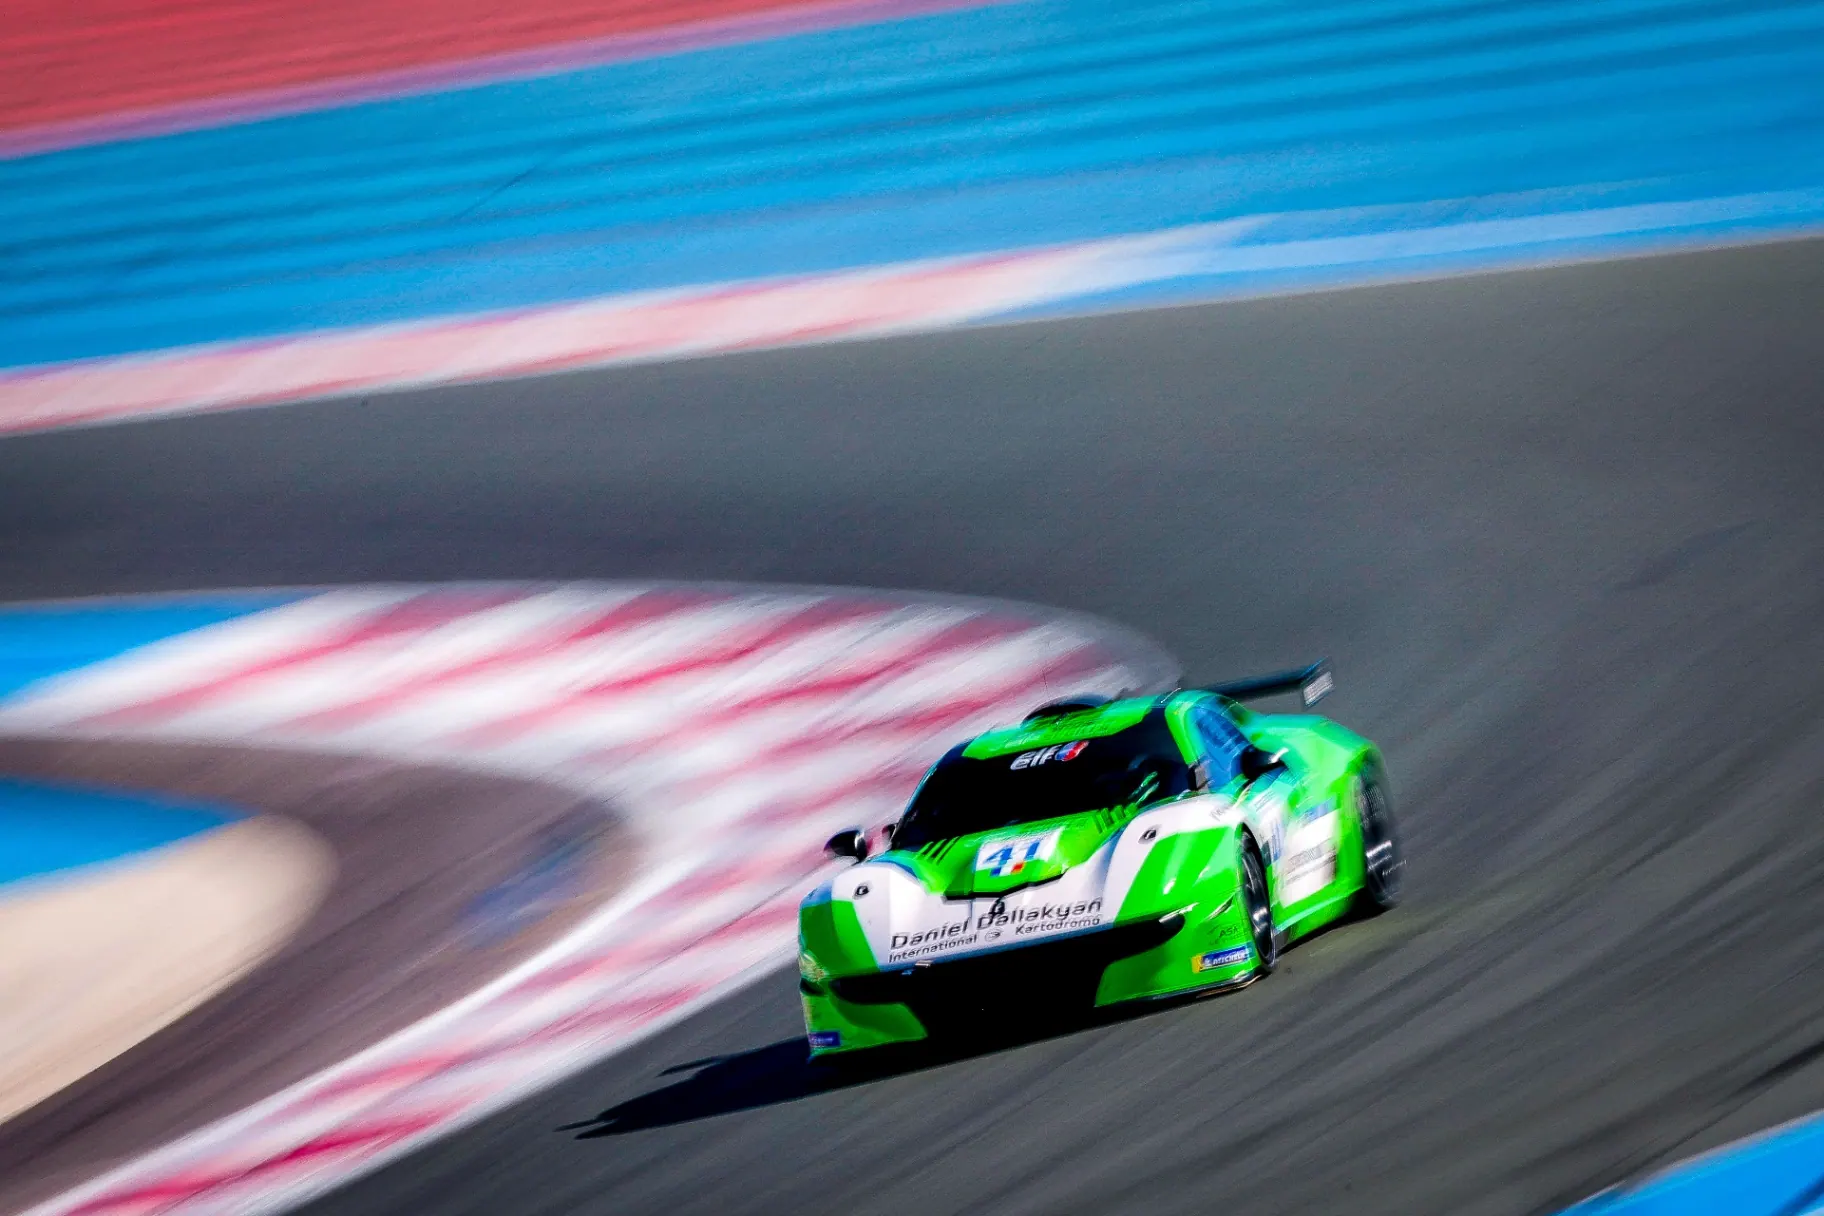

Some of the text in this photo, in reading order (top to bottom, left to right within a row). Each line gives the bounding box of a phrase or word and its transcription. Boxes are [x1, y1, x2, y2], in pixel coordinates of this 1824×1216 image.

[1010, 744, 1061, 770] elf
[984, 840, 1041, 868] 41
[888, 914, 1101, 963] International Kartodromo
[890, 897, 1103, 950] Daniel Dallakyan
